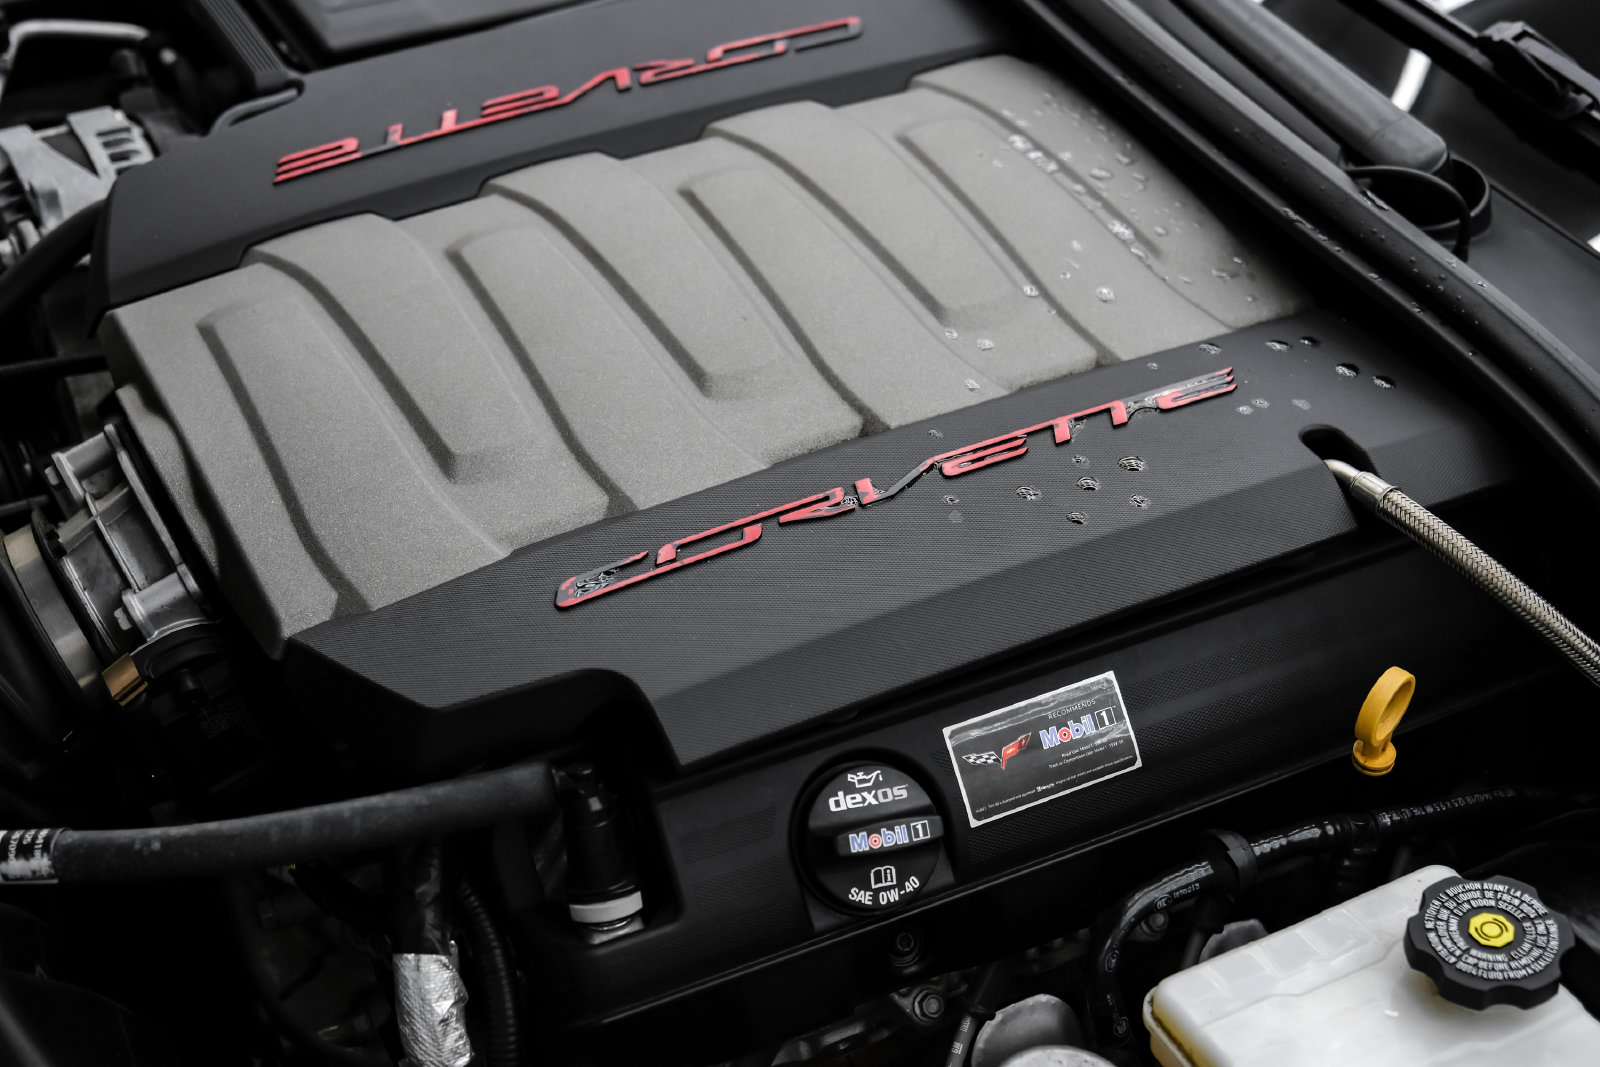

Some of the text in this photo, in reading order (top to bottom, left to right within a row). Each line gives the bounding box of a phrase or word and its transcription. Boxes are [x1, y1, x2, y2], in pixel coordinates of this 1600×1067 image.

[273, 15, 864, 185] CORVETTE
[554, 366, 1238, 611] CORVETTE
[1048, 698, 1096, 720] RECOMMENDS
[1039, 714, 1094, 749] Mobil
[829, 784, 908, 812] dexos
[849, 824, 909, 853] Mobil
[849, 876, 920, 905] SAE 0W-40
[1444, 899, 1457, 909] DU
[1455, 891, 1483, 904] LIQUIDE
[1485, 891, 1495, 899] DE
[1497, 892, 1520, 906] FREIN
[1424, 898, 1441, 929] NETTOYER
[1437, 893, 1448, 902] LE
[1446, 882, 1482, 898] BOUCHON
[1483, 882, 1510, 894] AVANT
[1510, 888, 1521, 898] LA
[1470, 899, 1495, 908] BIDON
[1498, 902, 1526, 921] SCELLE
[1510, 943, 1532, 959] CLEAN
[1478, 961, 1511, 971] BEFORE
[1478, 969, 1504, 981] FLUID
[1503, 968, 1528, 980] FROM
[1525, 965, 1535, 976] A
[1531, 952, 1554, 973] SEALED
